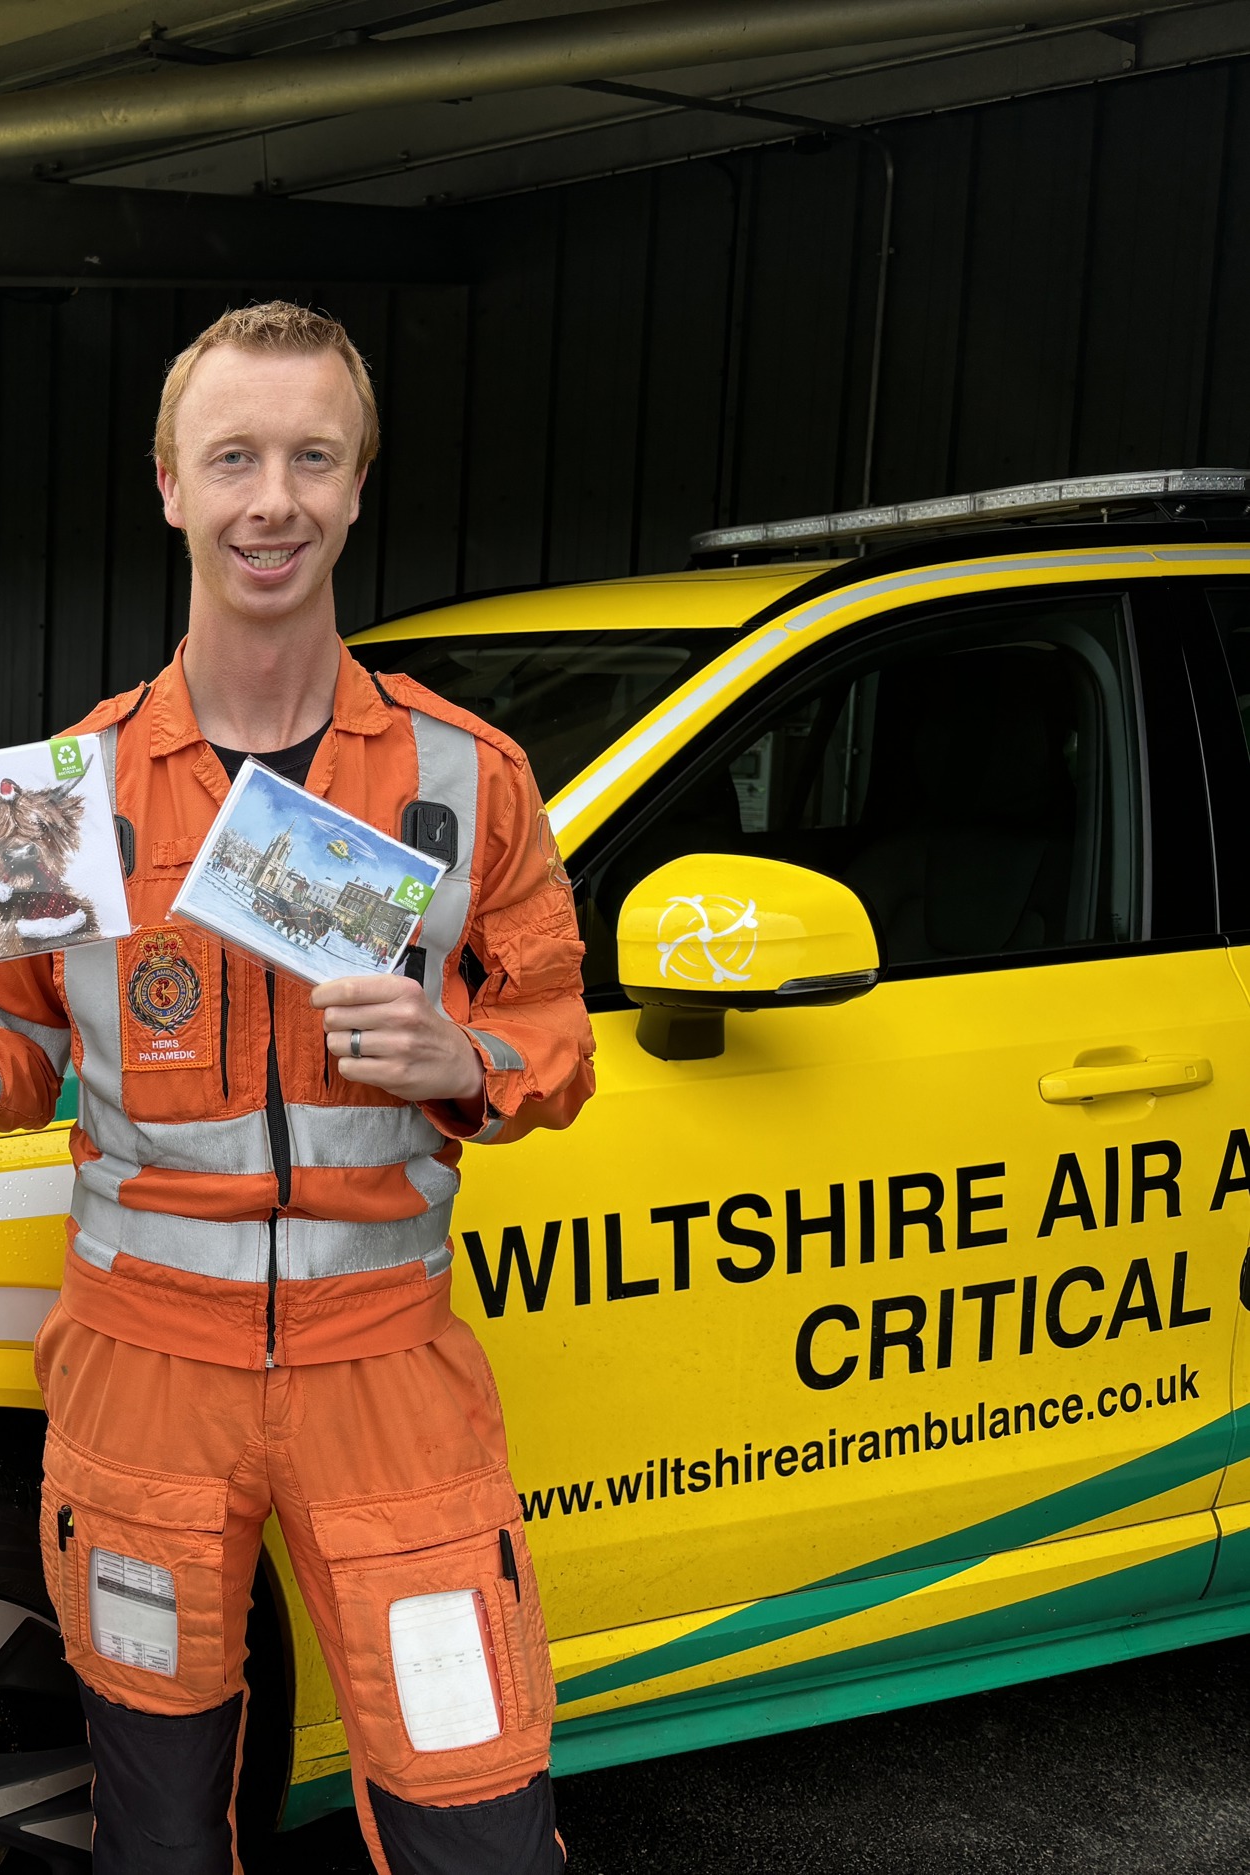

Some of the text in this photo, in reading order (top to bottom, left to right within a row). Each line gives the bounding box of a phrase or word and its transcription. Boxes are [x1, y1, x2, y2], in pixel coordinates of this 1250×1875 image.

[138, 1050, 196, 1061] PARAMEDIC
[152, 1039, 180, 1050] HEMS
[461, 1161, 1008, 1319] WILTSHIRE
[1037, 1139, 1182, 1239] AIR
[794, 1250, 1211, 1391] CRITICAL
[518, 1363, 1200, 1522] ww.wiltshireairambulance.co.uk
